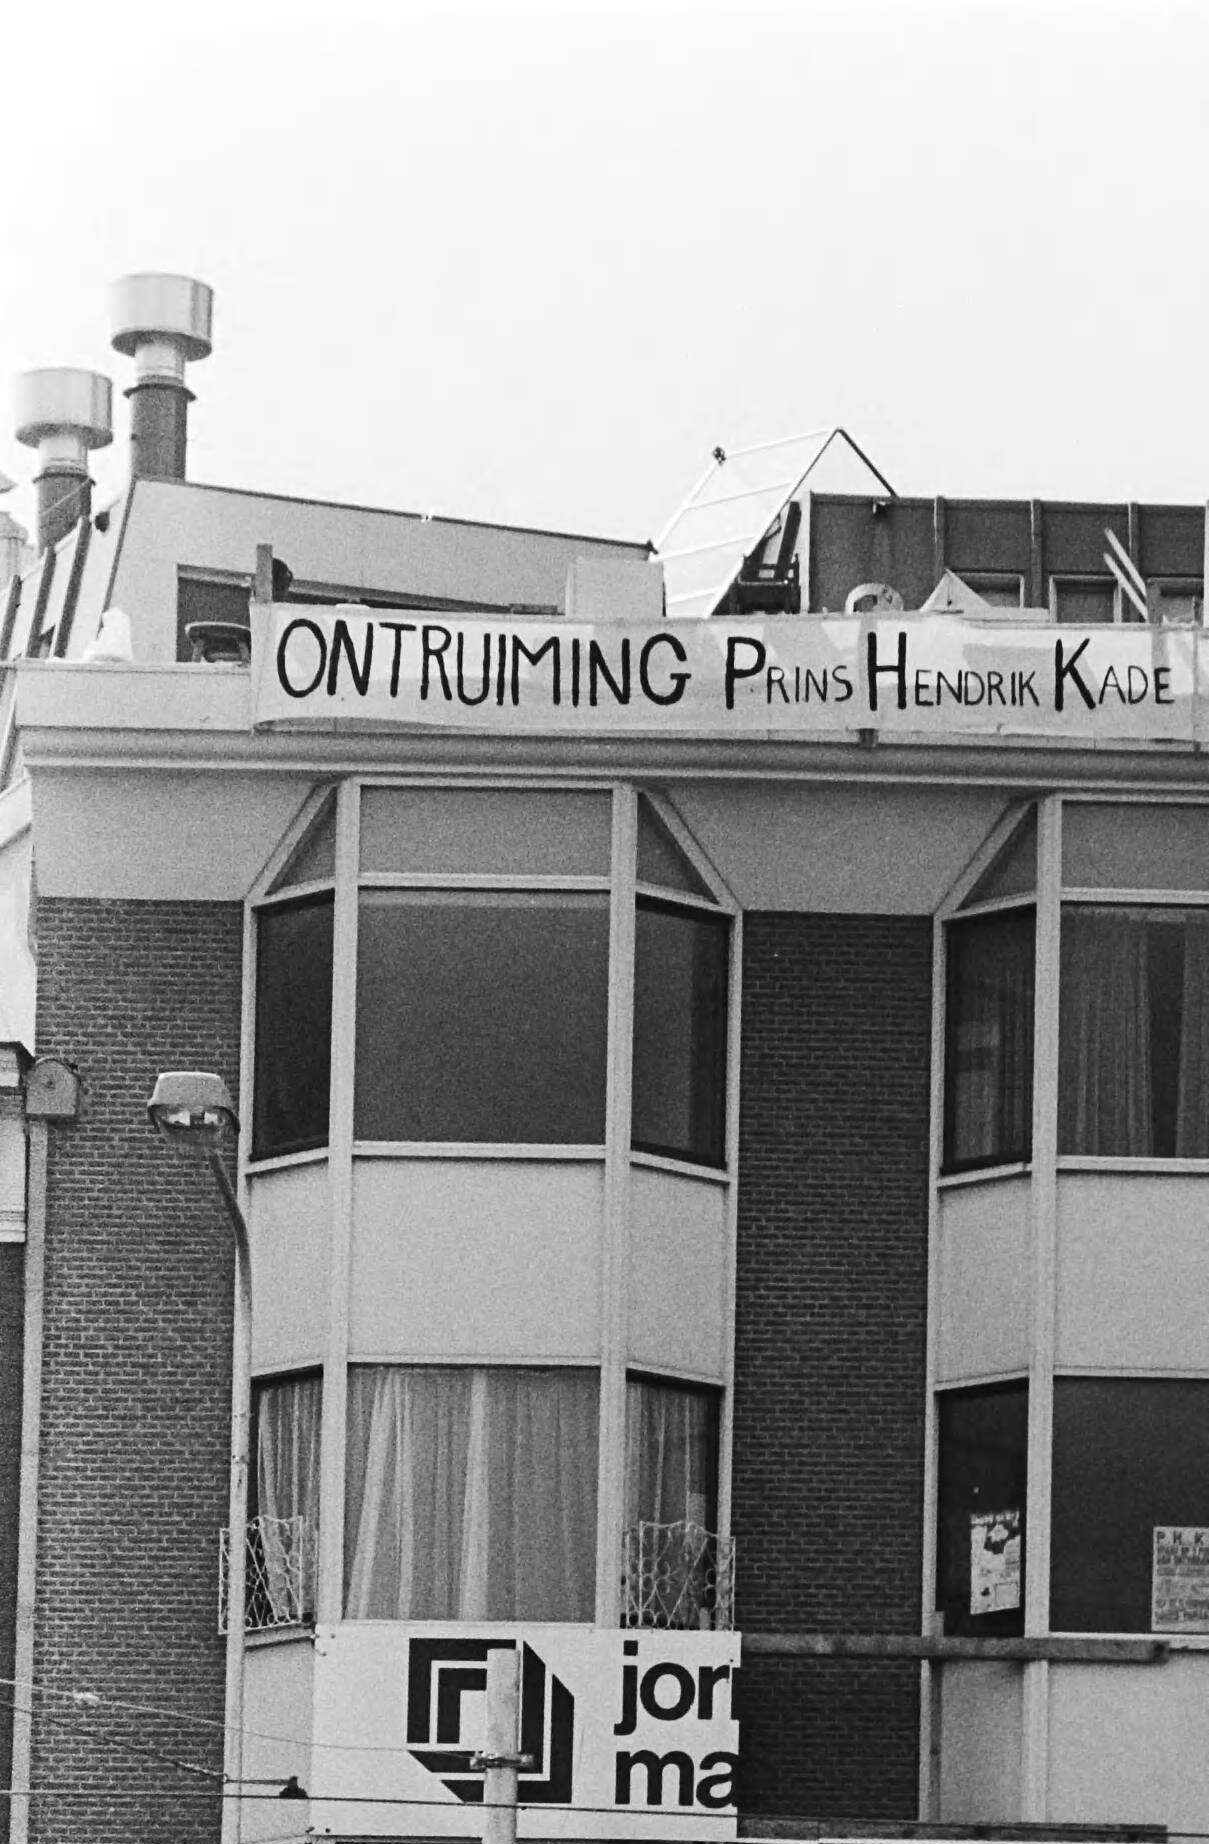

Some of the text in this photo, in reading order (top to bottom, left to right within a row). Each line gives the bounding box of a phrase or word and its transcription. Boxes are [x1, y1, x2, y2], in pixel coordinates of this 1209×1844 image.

[277, 619, 692, 708] ONTRUIMING
[723, 639, 854, 712] PRINS
[867, 631, 1039, 712] HENDRIK
[1054, 638, 1176, 712] KADE
[615, 1749, 740, 1809] ma
